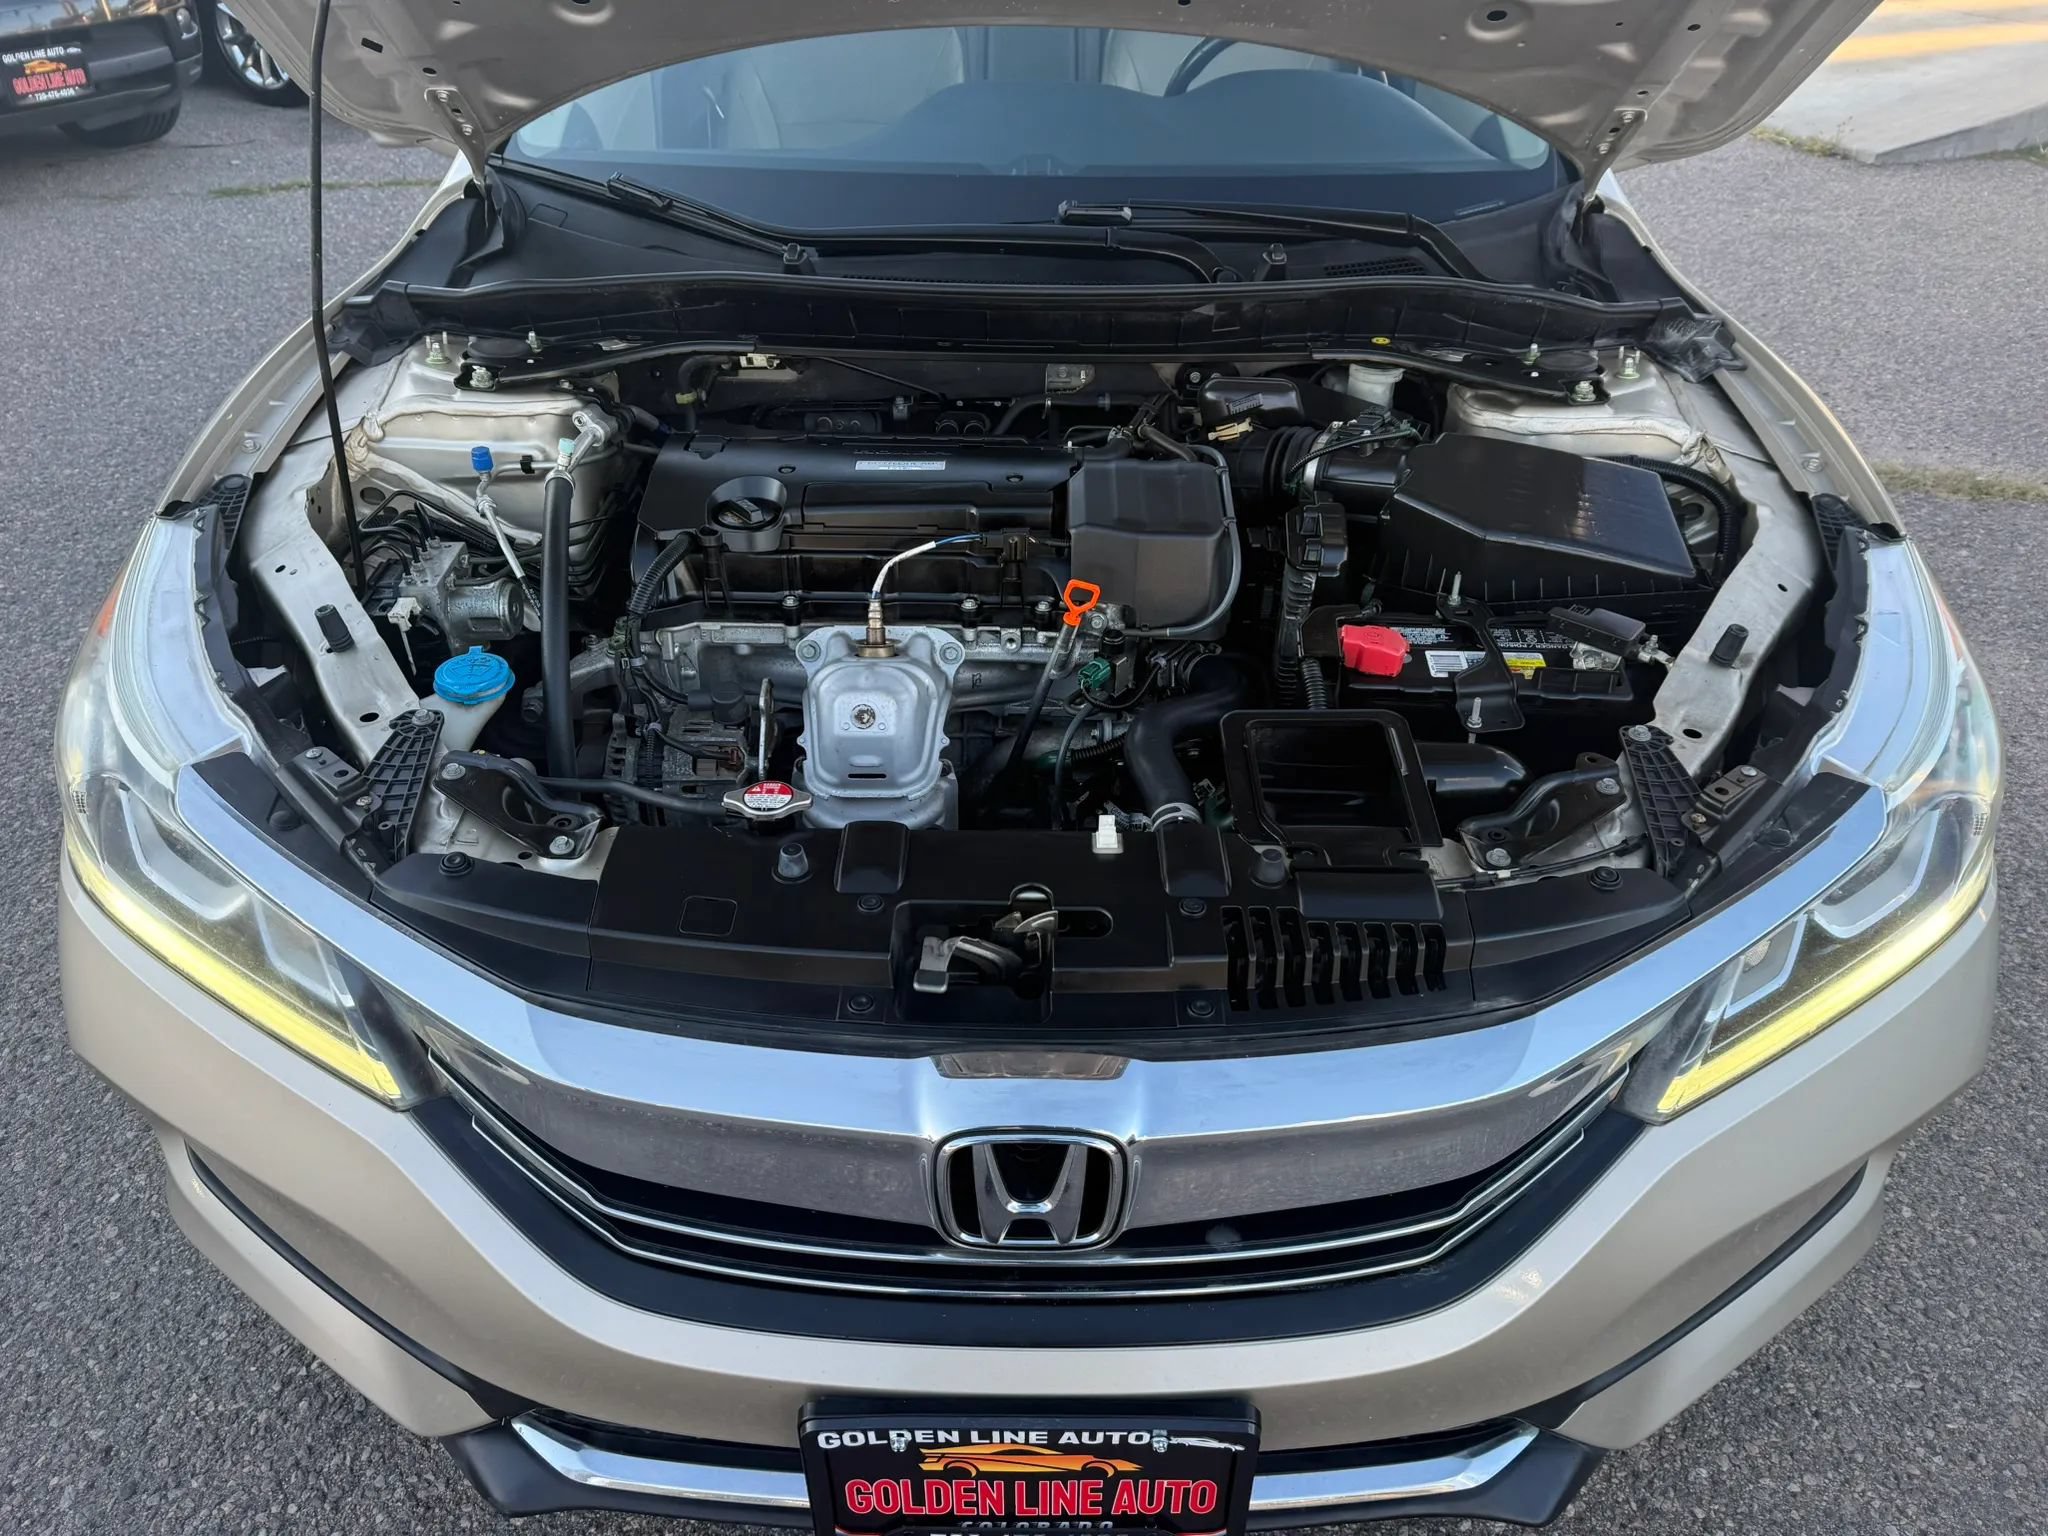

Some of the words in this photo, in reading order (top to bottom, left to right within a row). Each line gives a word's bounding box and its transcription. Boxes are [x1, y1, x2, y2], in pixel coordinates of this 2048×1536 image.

[2, 51, 30, 64] GOLDEN
[30, 48, 46, 59] LINE
[47, 46, 64, 57] AUTO
[45, 71, 66, 90] LINE
[64, 68, 87, 86] AUTO
[817, 1429, 960, 1449] GOLDEN
[970, 1430, 1049, 1444] LINE
[1058, 1431, 1151, 1445] AUTO
[845, 1478, 1005, 1516] GOLDEN
[1015, 1479, 1104, 1516] LINE
[1111, 1479, 1218, 1515] AUTO
